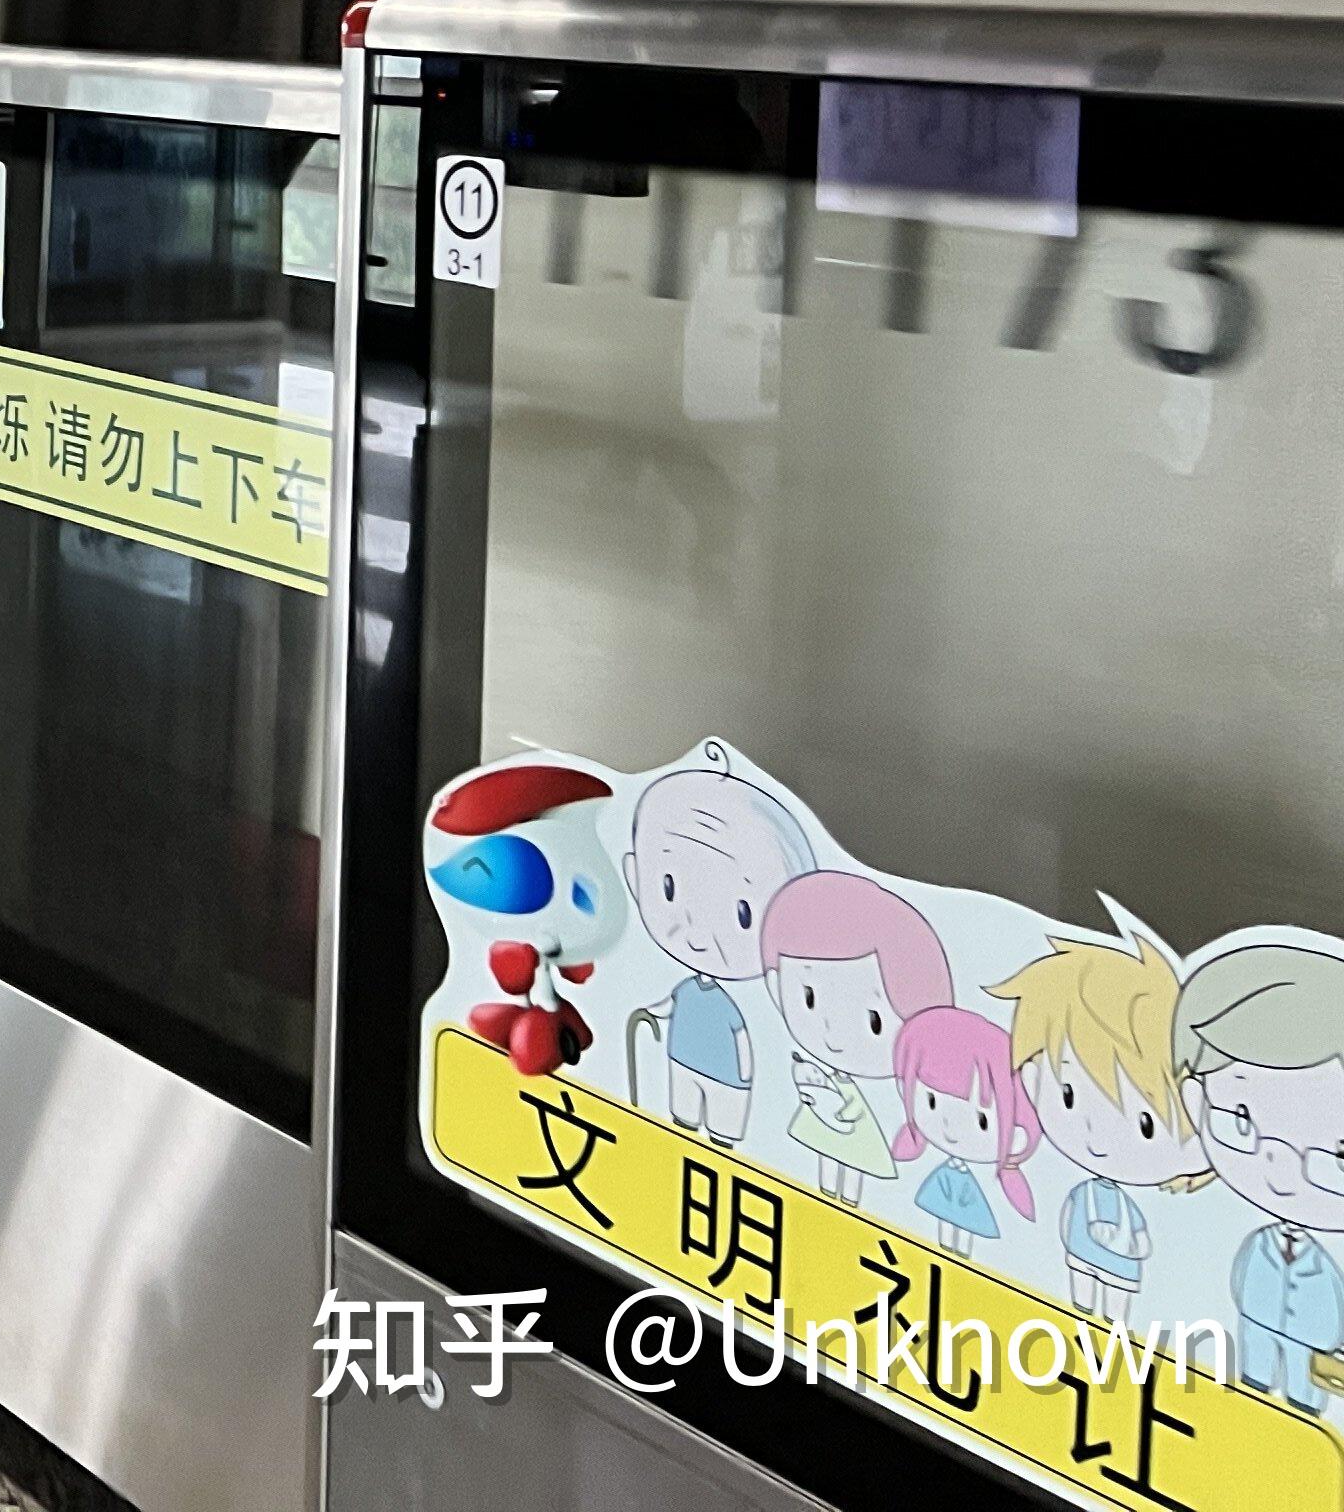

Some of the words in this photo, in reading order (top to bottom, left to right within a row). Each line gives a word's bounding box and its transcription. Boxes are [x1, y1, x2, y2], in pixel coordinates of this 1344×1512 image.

[454, 180, 482, 219] 11
[447, 248, 483, 280] 3-1
[45, 400, 327, 544] 请勿上下车
[516, 1090, 1197, 1512] 文明礼让
